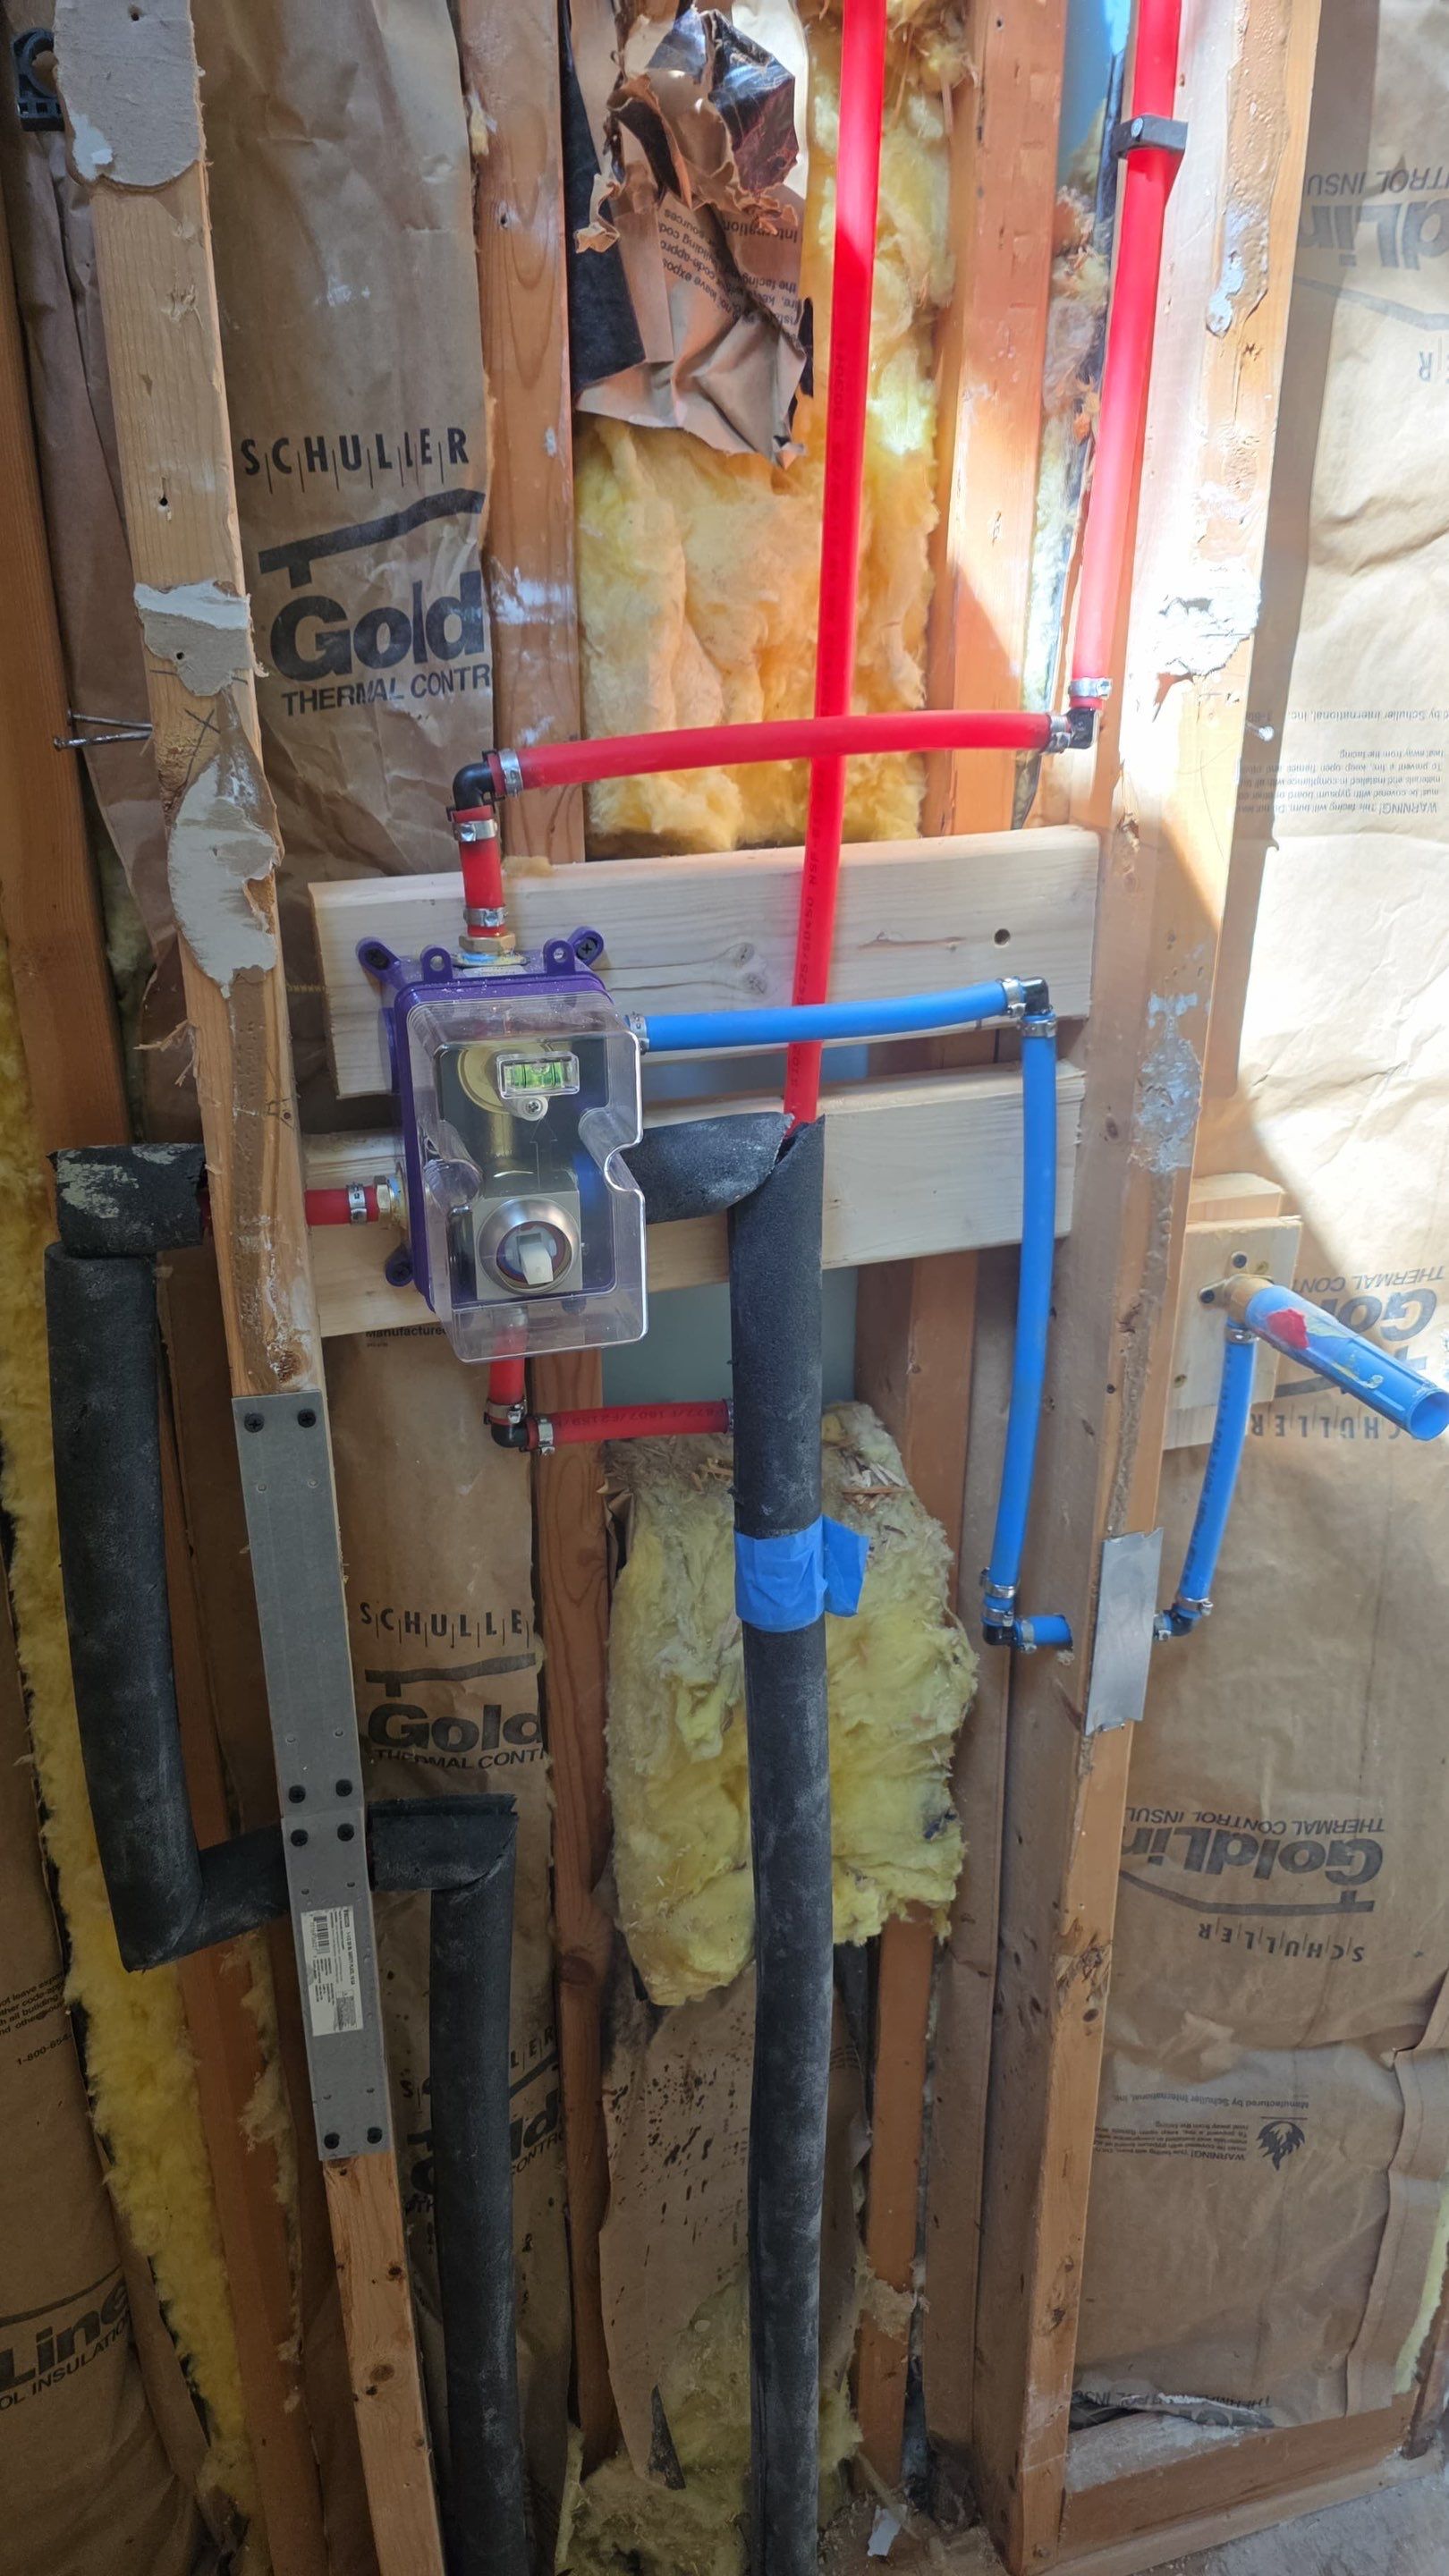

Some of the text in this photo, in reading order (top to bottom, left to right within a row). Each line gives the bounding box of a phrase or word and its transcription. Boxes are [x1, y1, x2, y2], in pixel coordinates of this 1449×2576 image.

[270, 571, 485, 682] Gold
[282, 677, 405, 716] THERMAL
[1379, 802, 1437, 815] WARNING!
[1352, 1266, 1445, 1291] THERMAL
[1192, 1811, 1286, 1835] CONTROL
[1292, 1818, 1385, 1836] THERMAL
[1197, 1923, 1365, 1962] SCHULLER
[1190, 2095, 1230, 2106] Schuller
[1232, 2097, 1243, 2107] by
[1245, 2100, 1309, 2109] Manufactured
[1191, 2150, 1245, 2161] WARNING!
